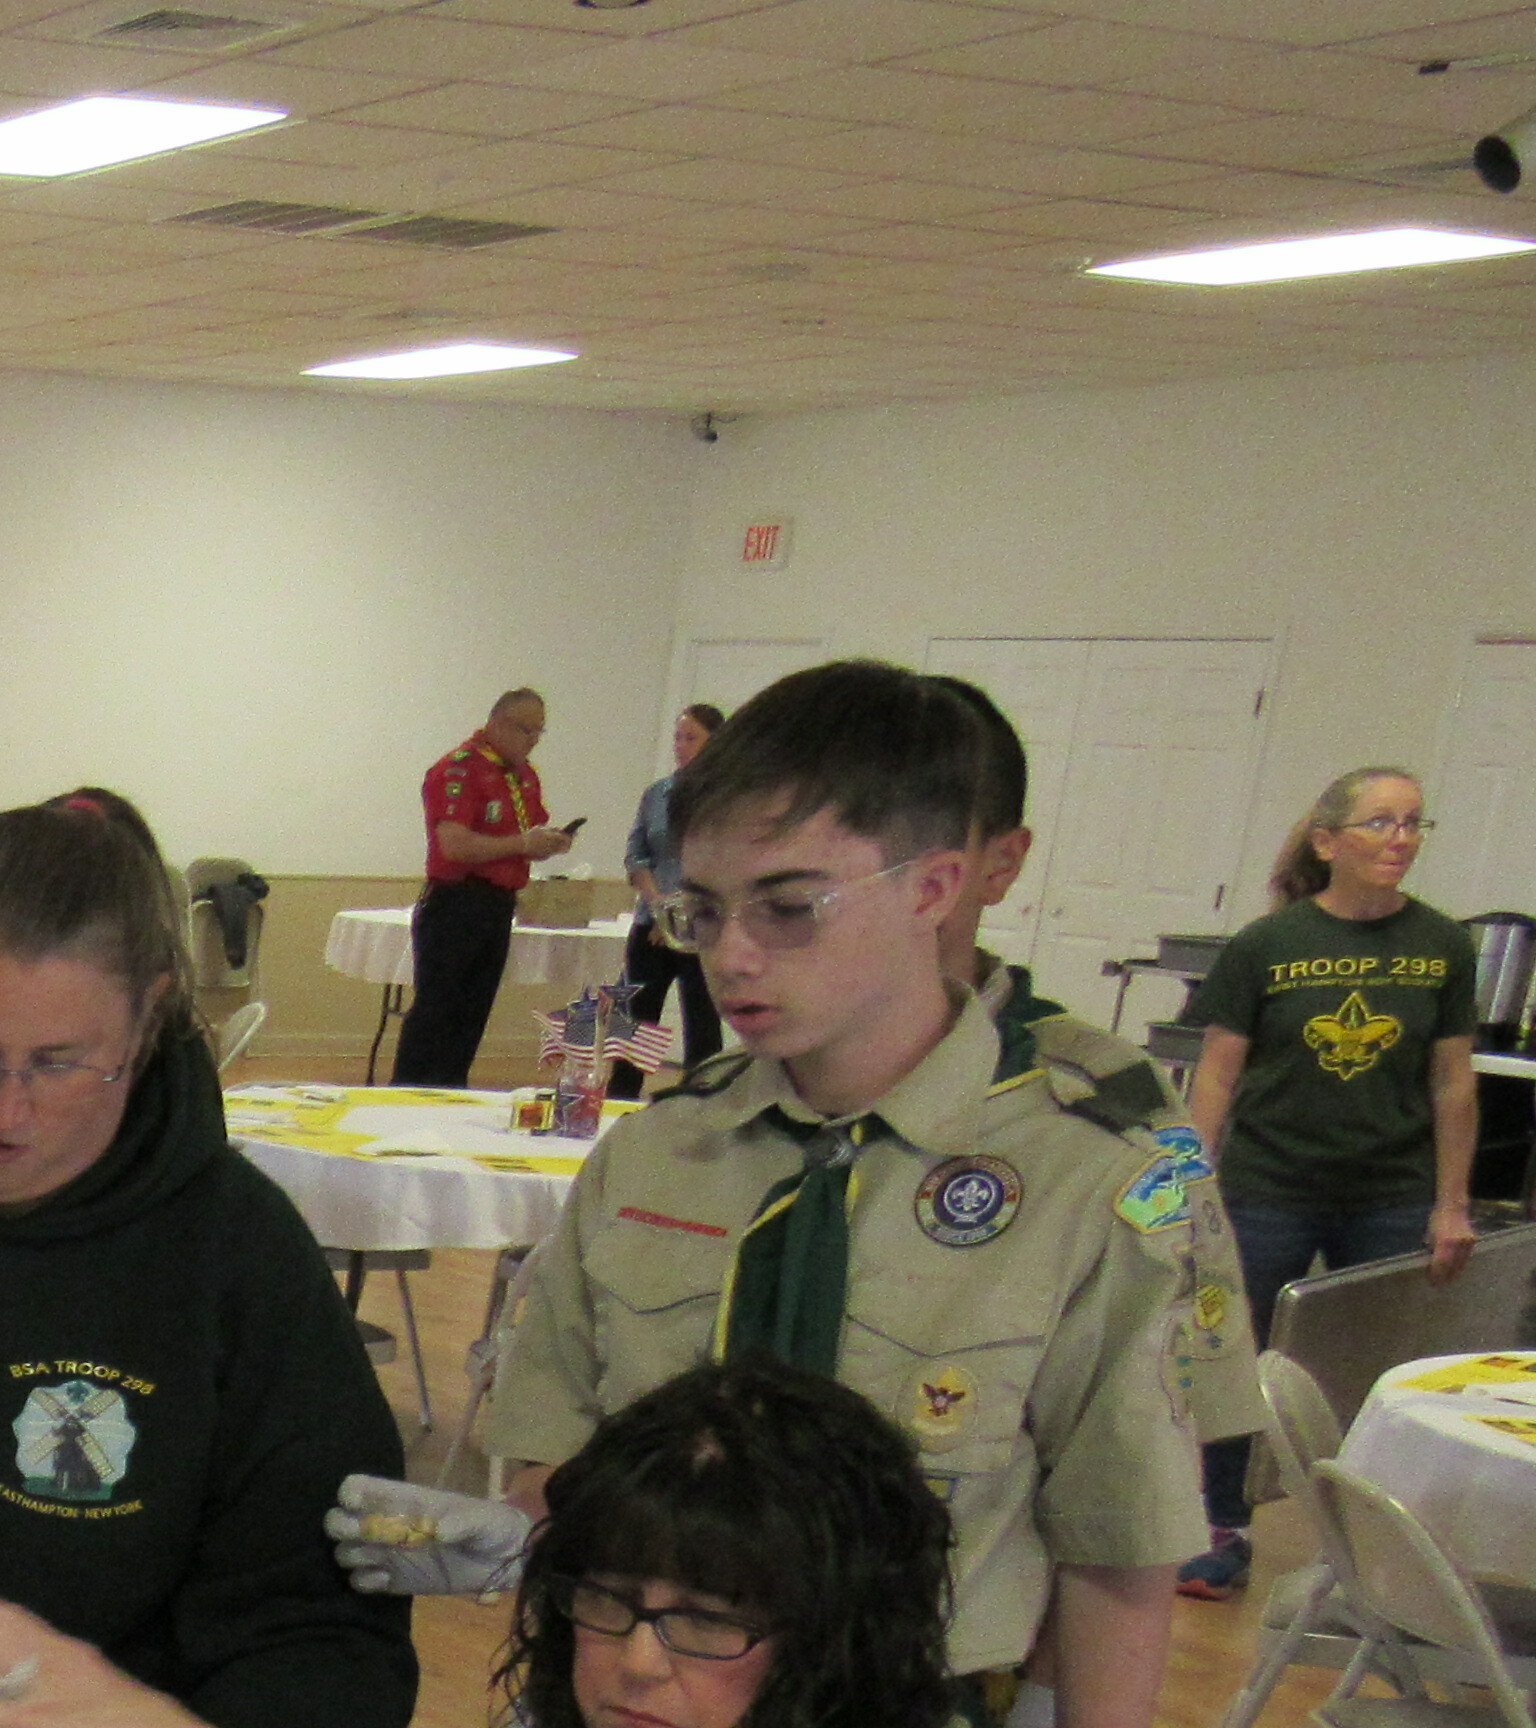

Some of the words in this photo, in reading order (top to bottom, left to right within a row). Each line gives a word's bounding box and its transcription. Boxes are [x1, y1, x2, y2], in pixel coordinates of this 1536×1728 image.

[743, 525, 780, 562] EXIT
[1268, 957, 1378, 982] TROOP
[1389, 957, 1448, 976] 298
[9, 1363, 50, 1378] BSA
[54, 1361, 120, 1380] TROOP
[121, 1376, 156, 1395] 298
